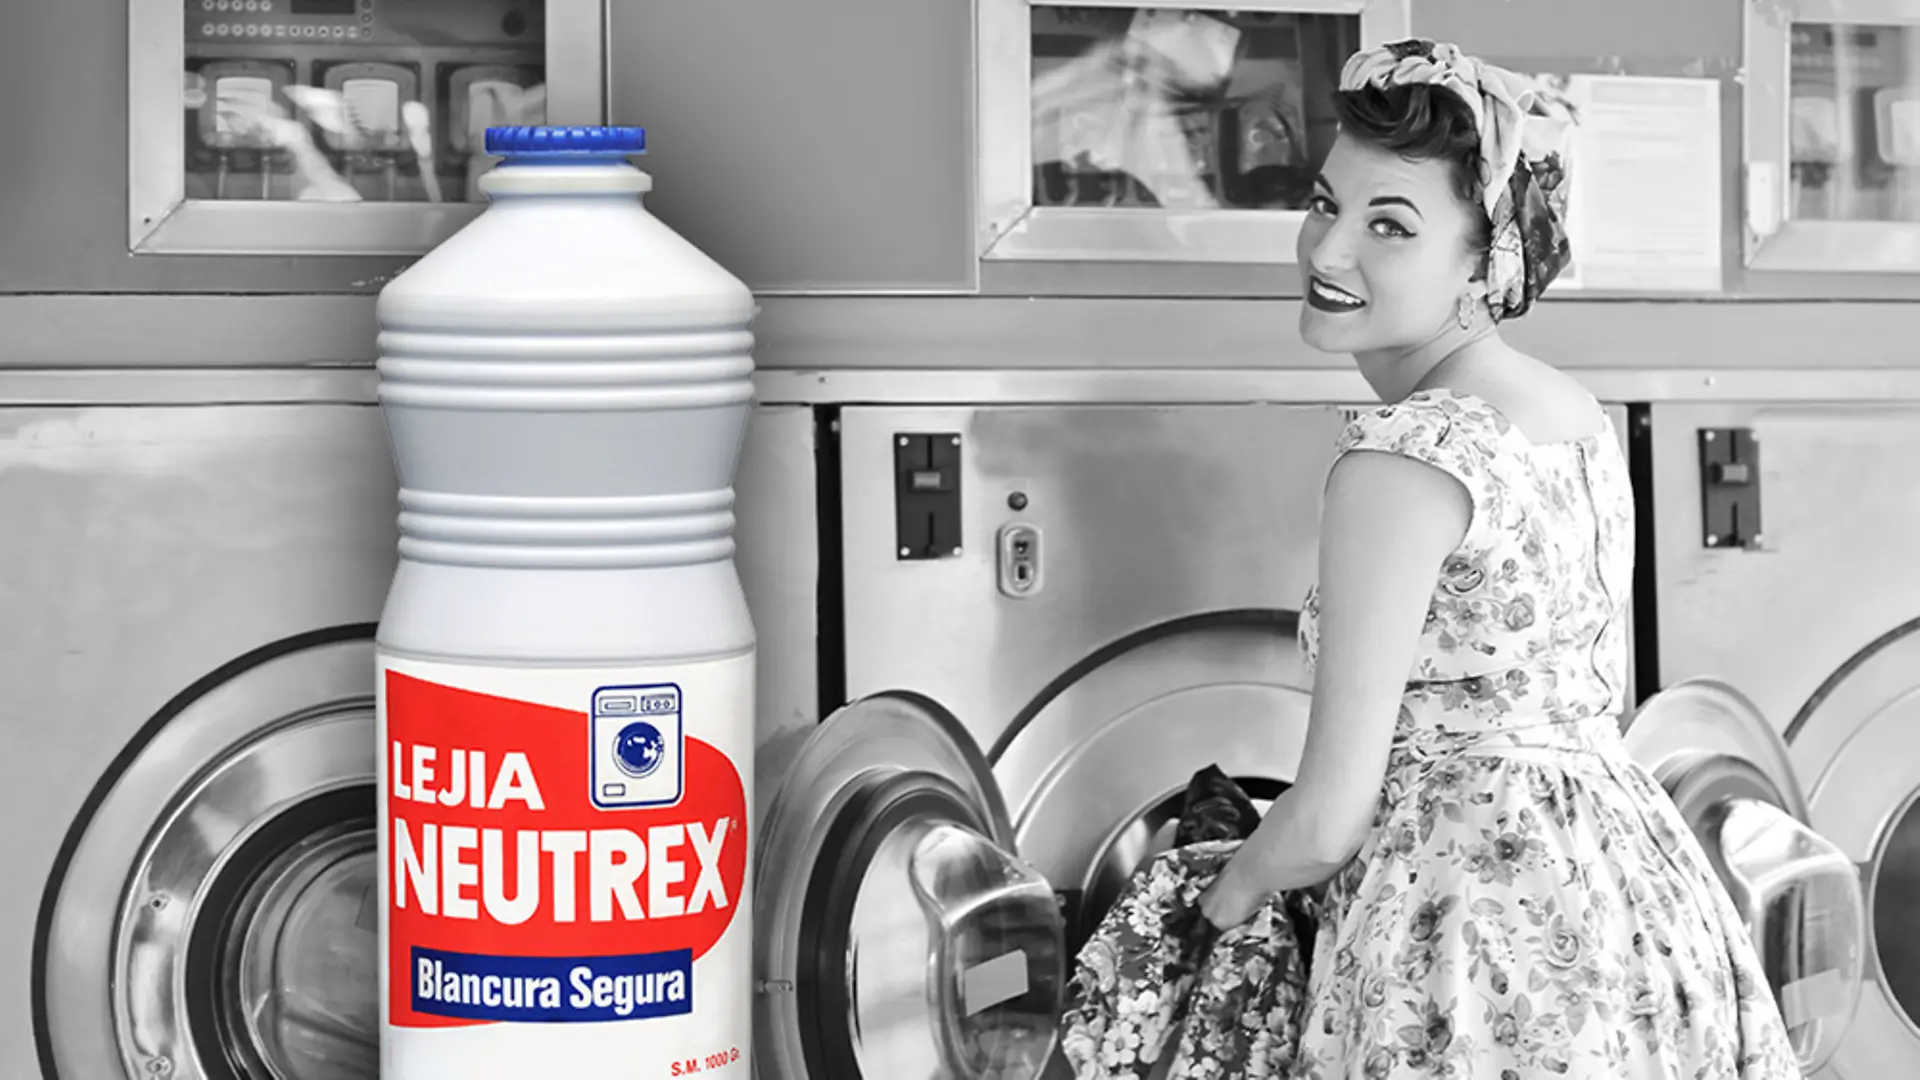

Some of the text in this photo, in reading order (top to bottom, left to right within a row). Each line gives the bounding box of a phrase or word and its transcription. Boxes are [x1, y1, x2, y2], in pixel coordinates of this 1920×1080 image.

[394, 741, 545, 810] LEJIA
[395, 817, 730, 925] NEUTREX
[418, 957, 686, 1016] Blancura Segura
[671, 1058, 701, 1077] S.M.
[705, 1050, 729, 1070] 1000
